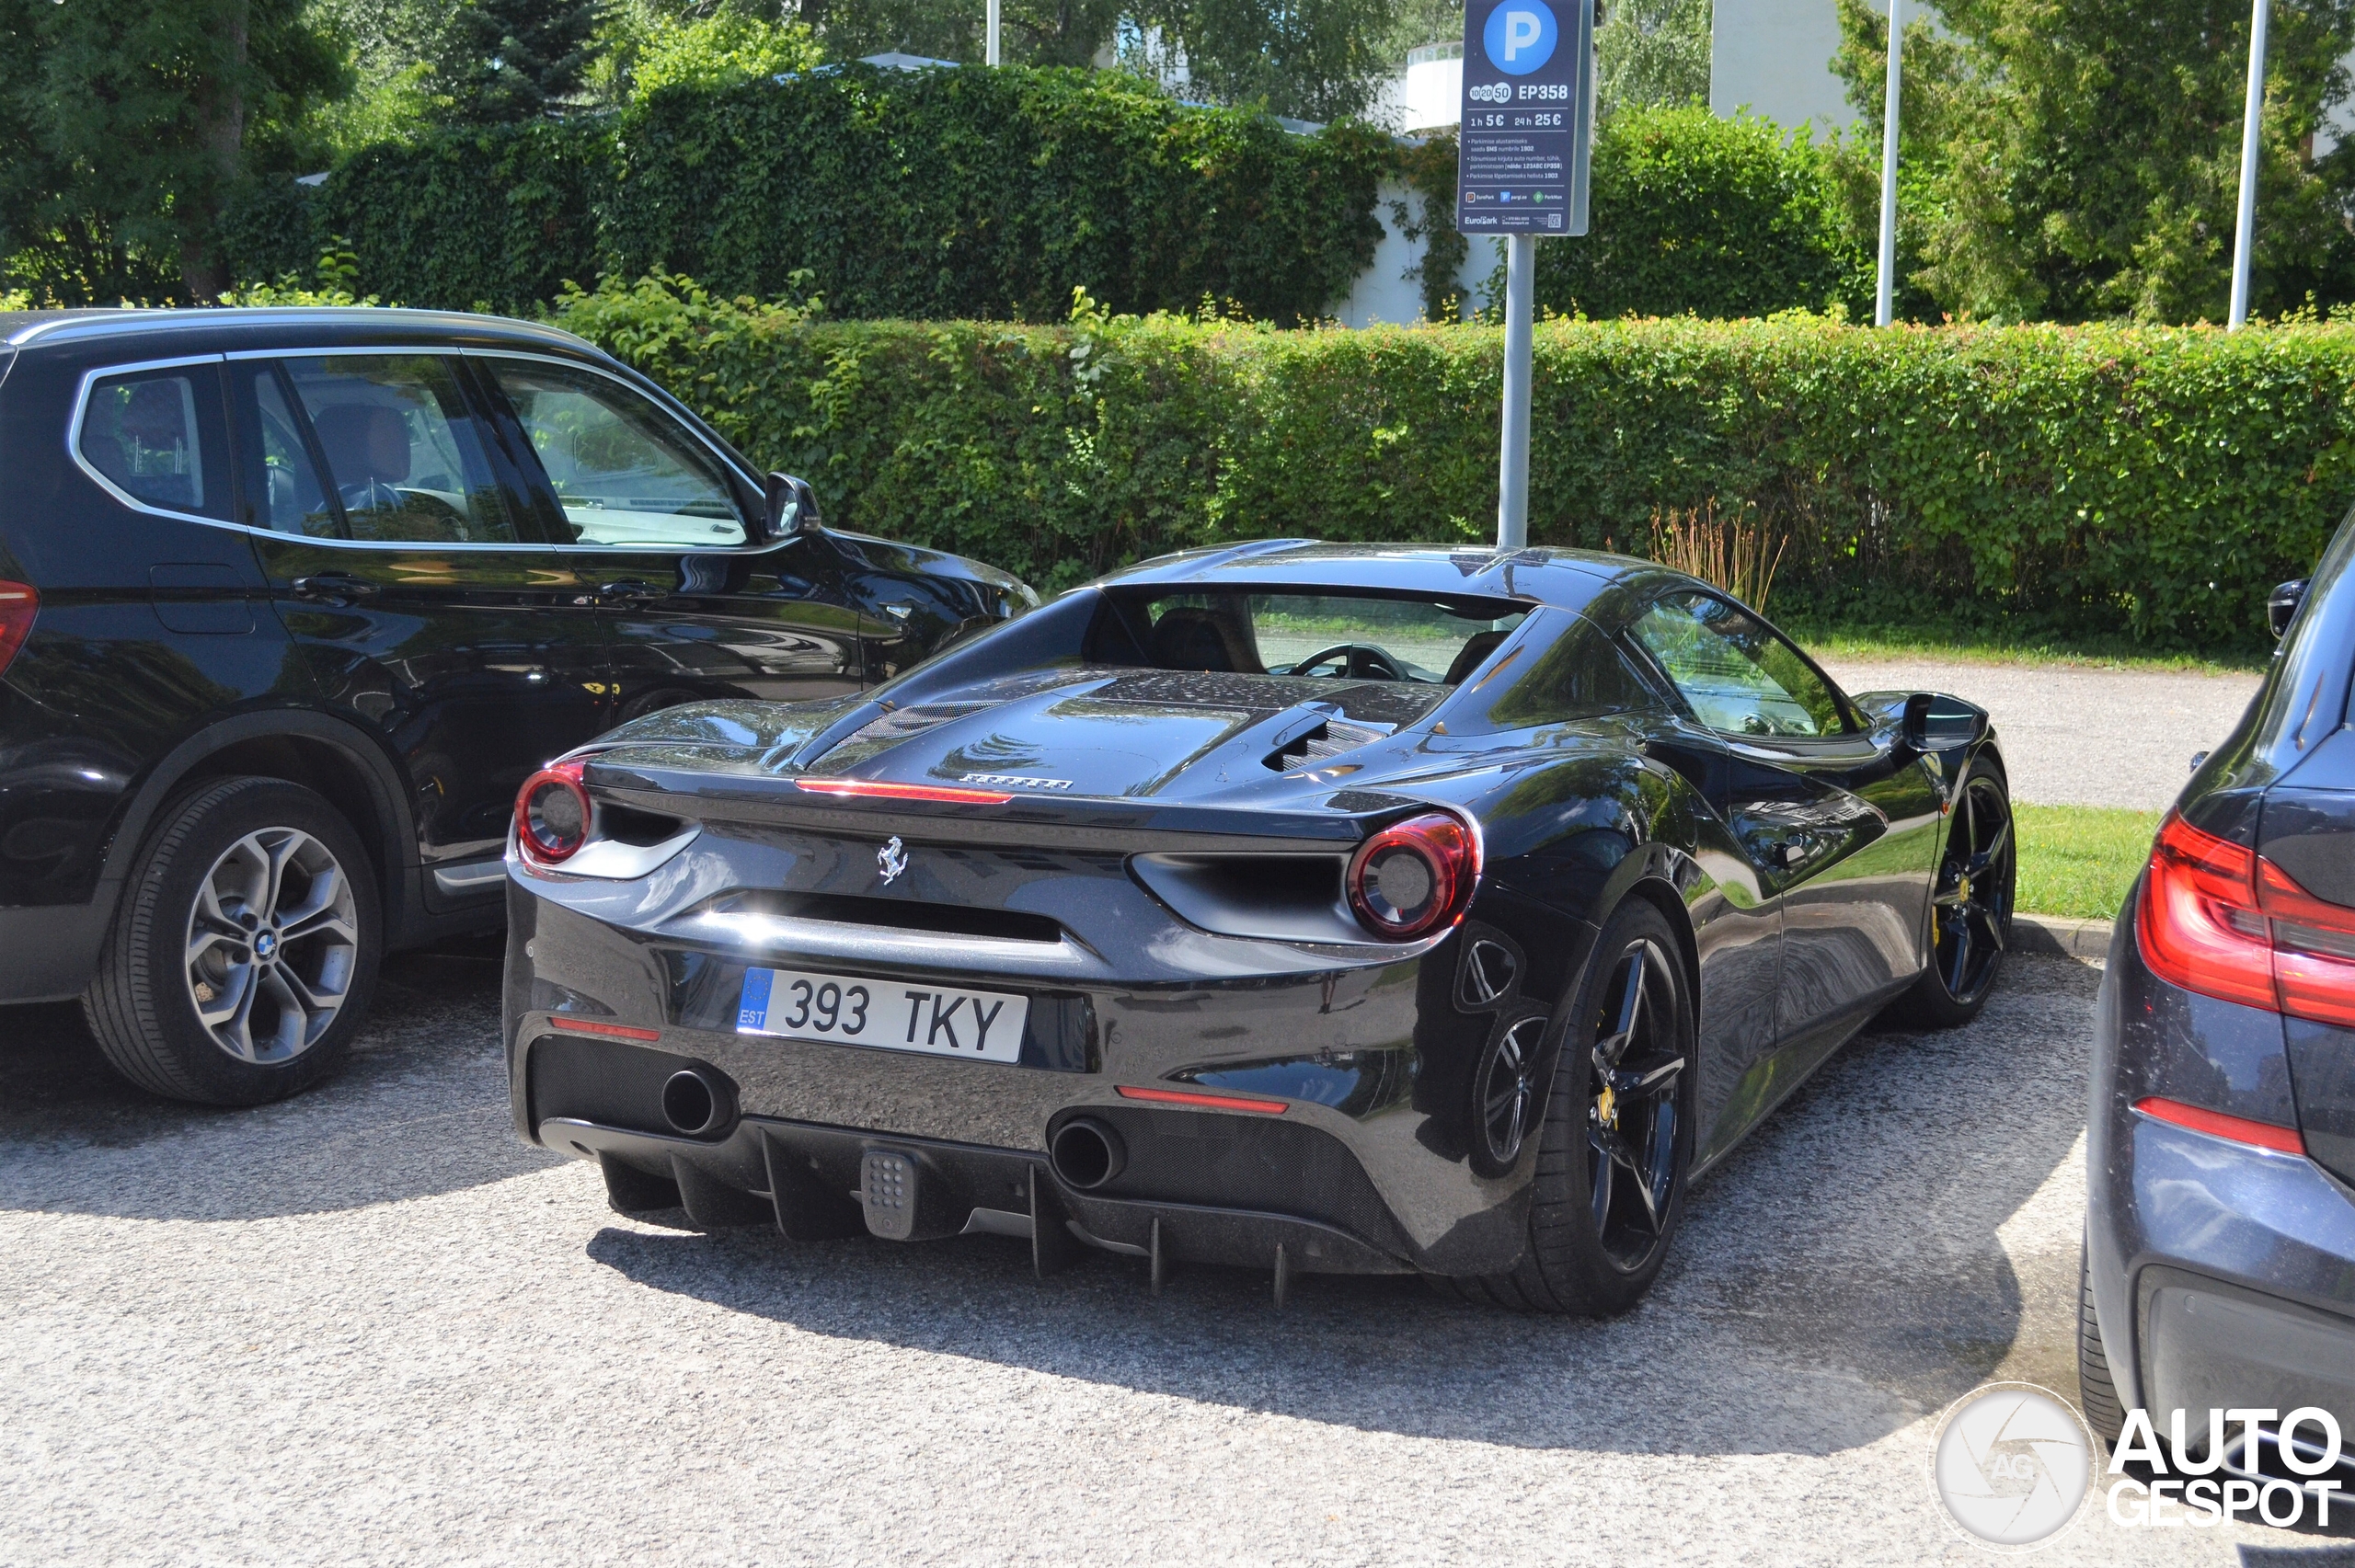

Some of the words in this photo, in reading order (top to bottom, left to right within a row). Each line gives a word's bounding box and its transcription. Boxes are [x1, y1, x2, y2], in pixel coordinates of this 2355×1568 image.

[1504, 11, 1542, 62] P
[1472, 89, 1478, 97] 10
[1481, 88, 1491, 97] 20
[1494, 87, 1509, 98] 50
[1518, 85, 1568, 100] EP358
[1514, 117, 1525, 126] 24
[739, 1009, 765, 1025] EST
[785, 979, 870, 1036] 393
[904, 990, 1005, 1051] TKY
